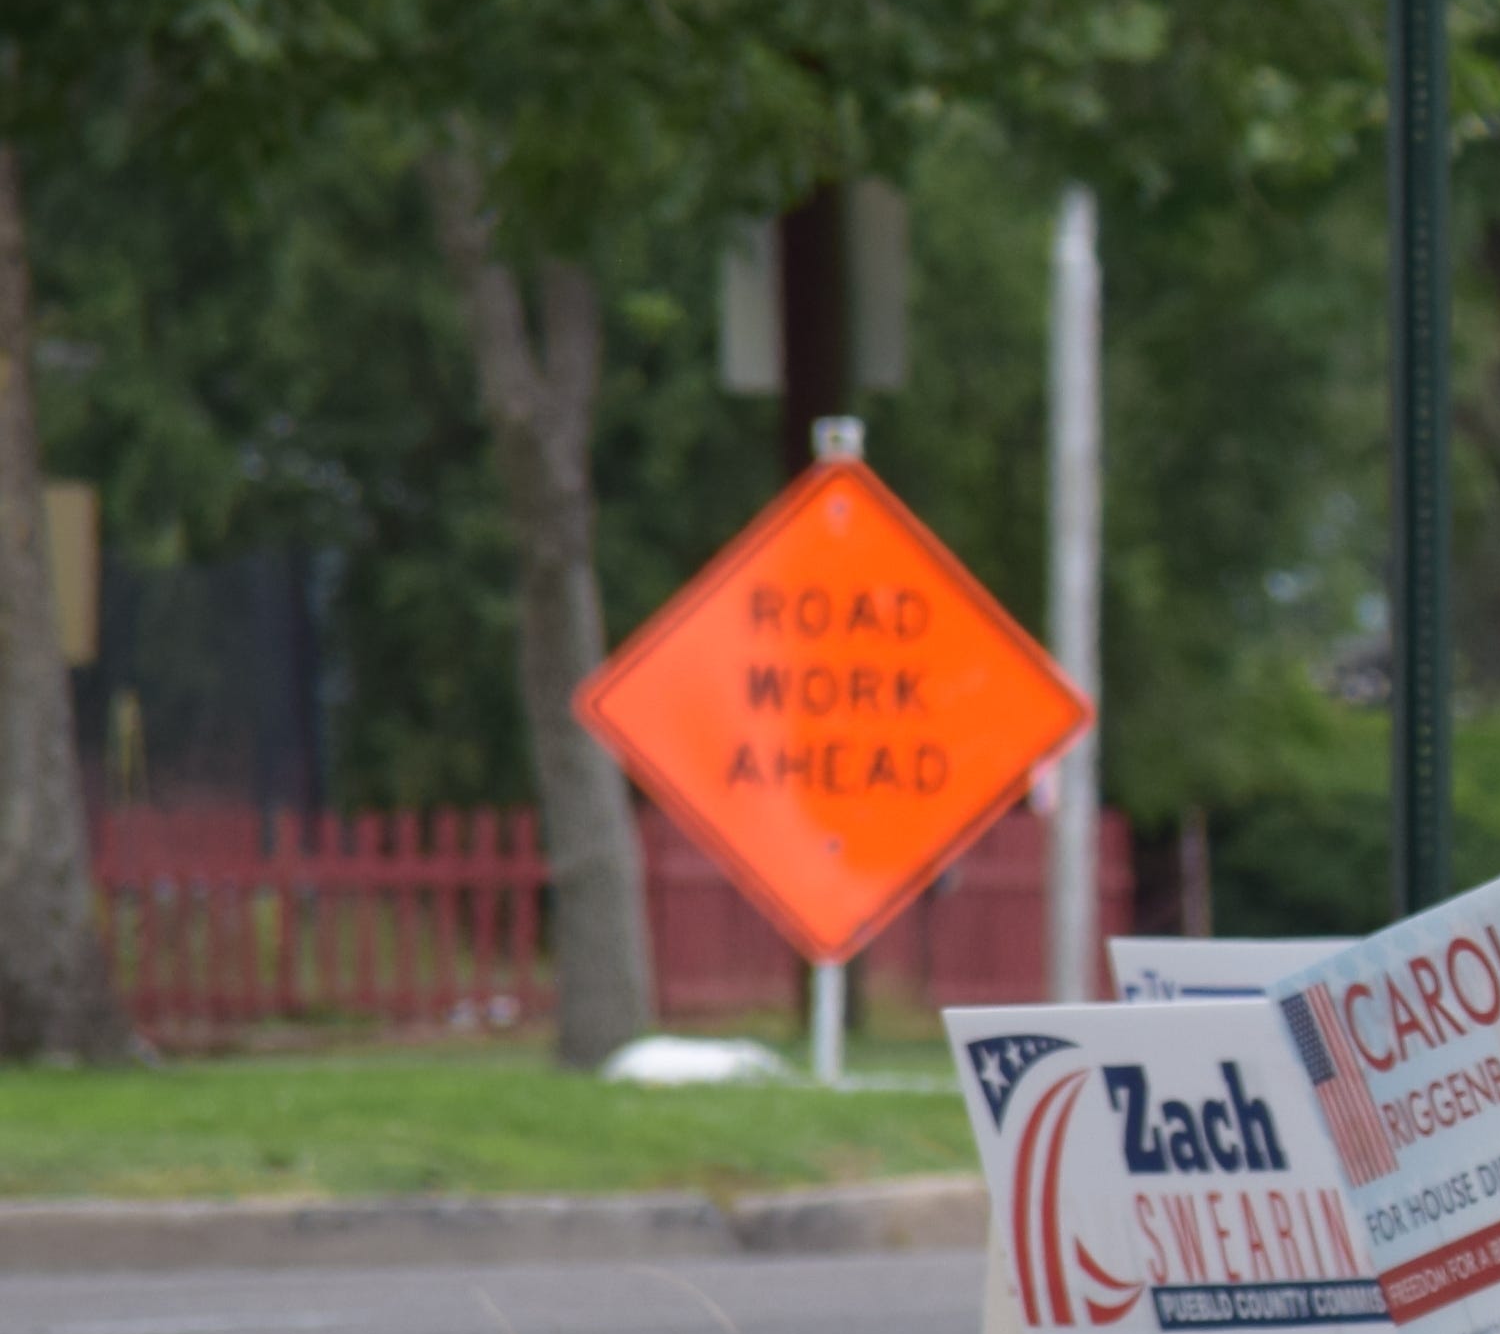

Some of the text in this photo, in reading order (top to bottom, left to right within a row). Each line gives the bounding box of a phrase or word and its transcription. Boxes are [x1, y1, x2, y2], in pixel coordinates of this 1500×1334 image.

[750, 587, 930, 640] ROAD
[746, 667, 927, 716] WORK
[727, 742, 949, 795] AHEAD
[1102, 1060, 1291, 1176] Zach
[1366, 1207, 1409, 1247] FOR
[1407, 1171, 1479, 1230] HOUSE
[1387, 1265, 1449, 1309] FREEDOM
[1448, 1249, 1478, 1283] FOR
[1477, 1245, 1491, 1271] A
[1159, 1291, 1235, 1323] PUEBLO
[1234, 1289, 1310, 1321] COUNTY
